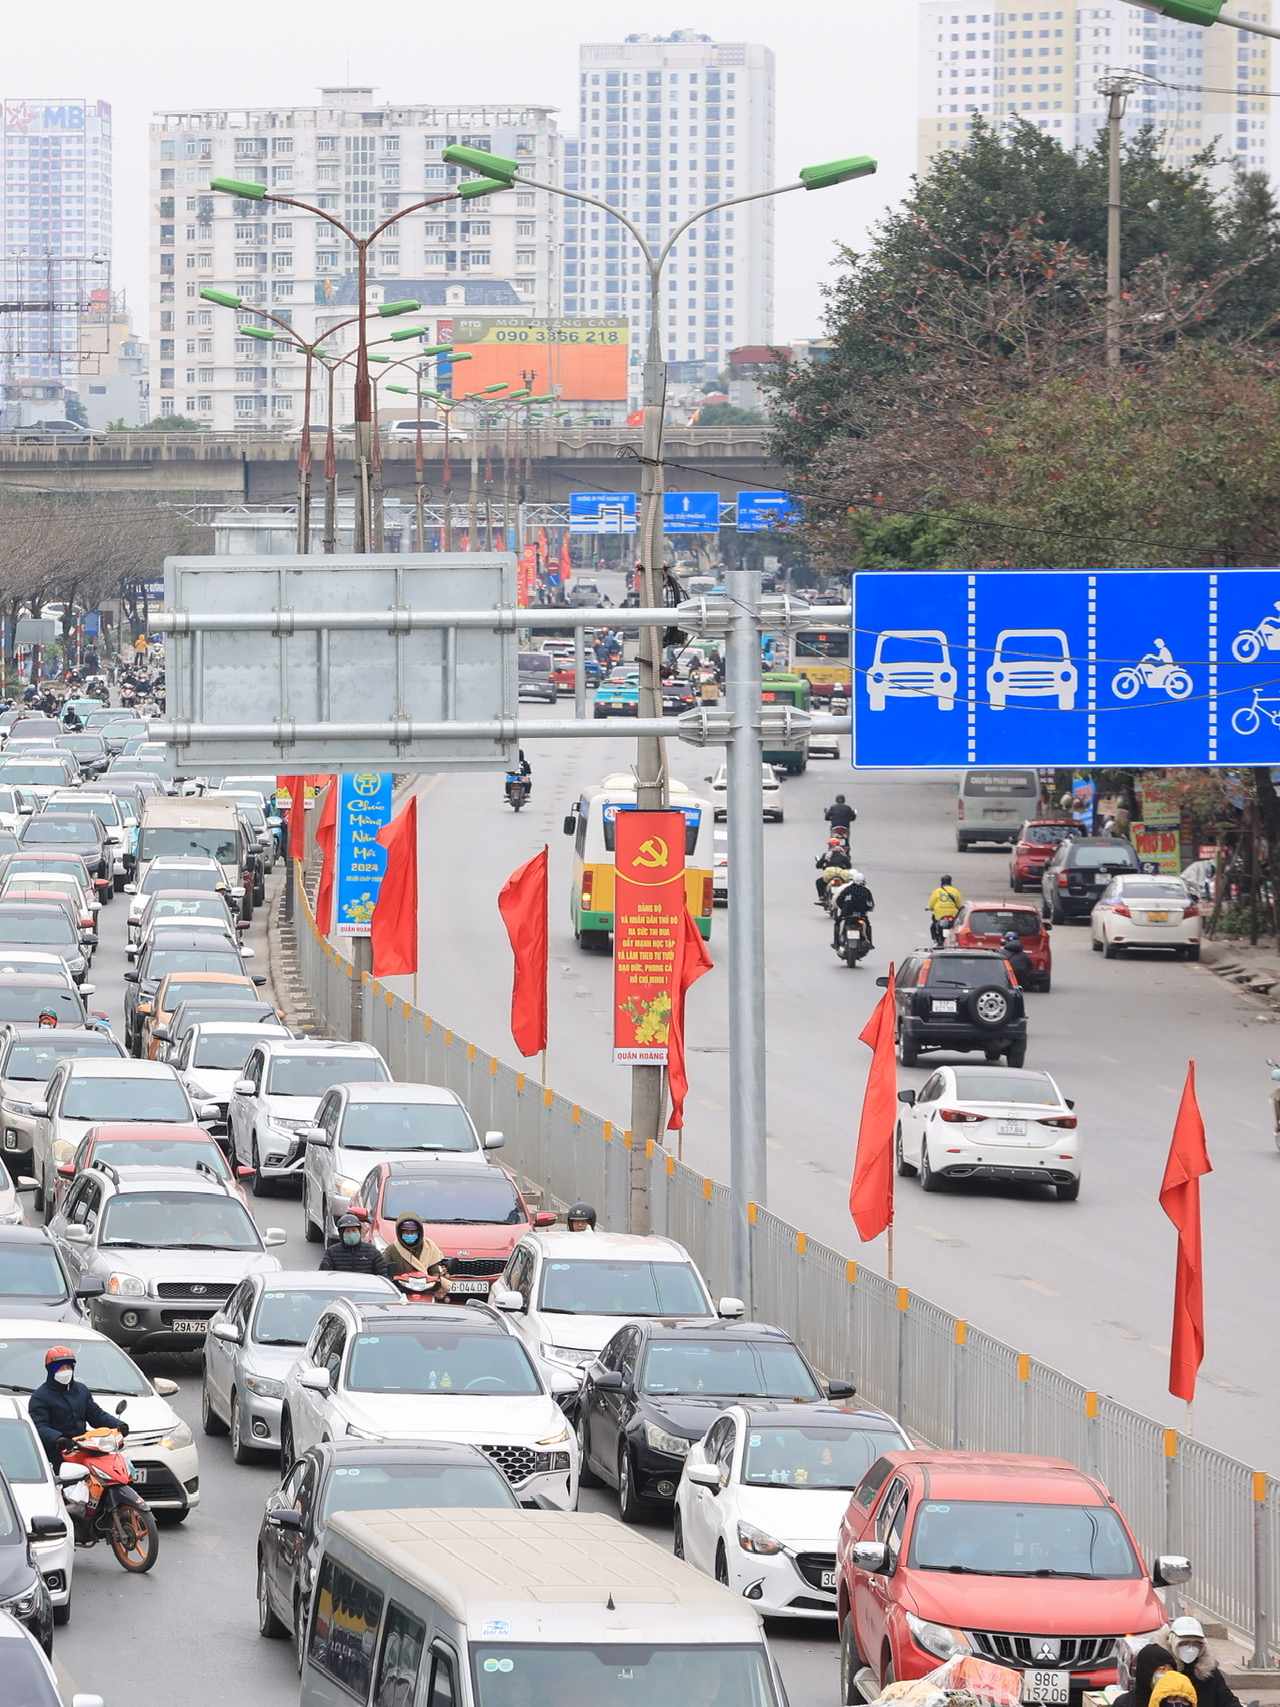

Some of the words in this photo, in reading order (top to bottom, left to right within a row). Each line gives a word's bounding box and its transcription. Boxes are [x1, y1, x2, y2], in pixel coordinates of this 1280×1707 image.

[43, 106, 84, 128] MB
[496, 330, 529, 342] 090
[586, 331, 618, 342] 218
[347, 800, 385, 811] Chúc
[351, 863, 378, 872] 2024
[617, 1052, 637, 1061] QUẬN
[639, 1052, 664, 1060] HOÀNG
[175, 1322, 206, 1332] 29A-75
[1035, 1672, 1059, 1687] 98C
[1026, 1687, 1067, 1702] 152.06
